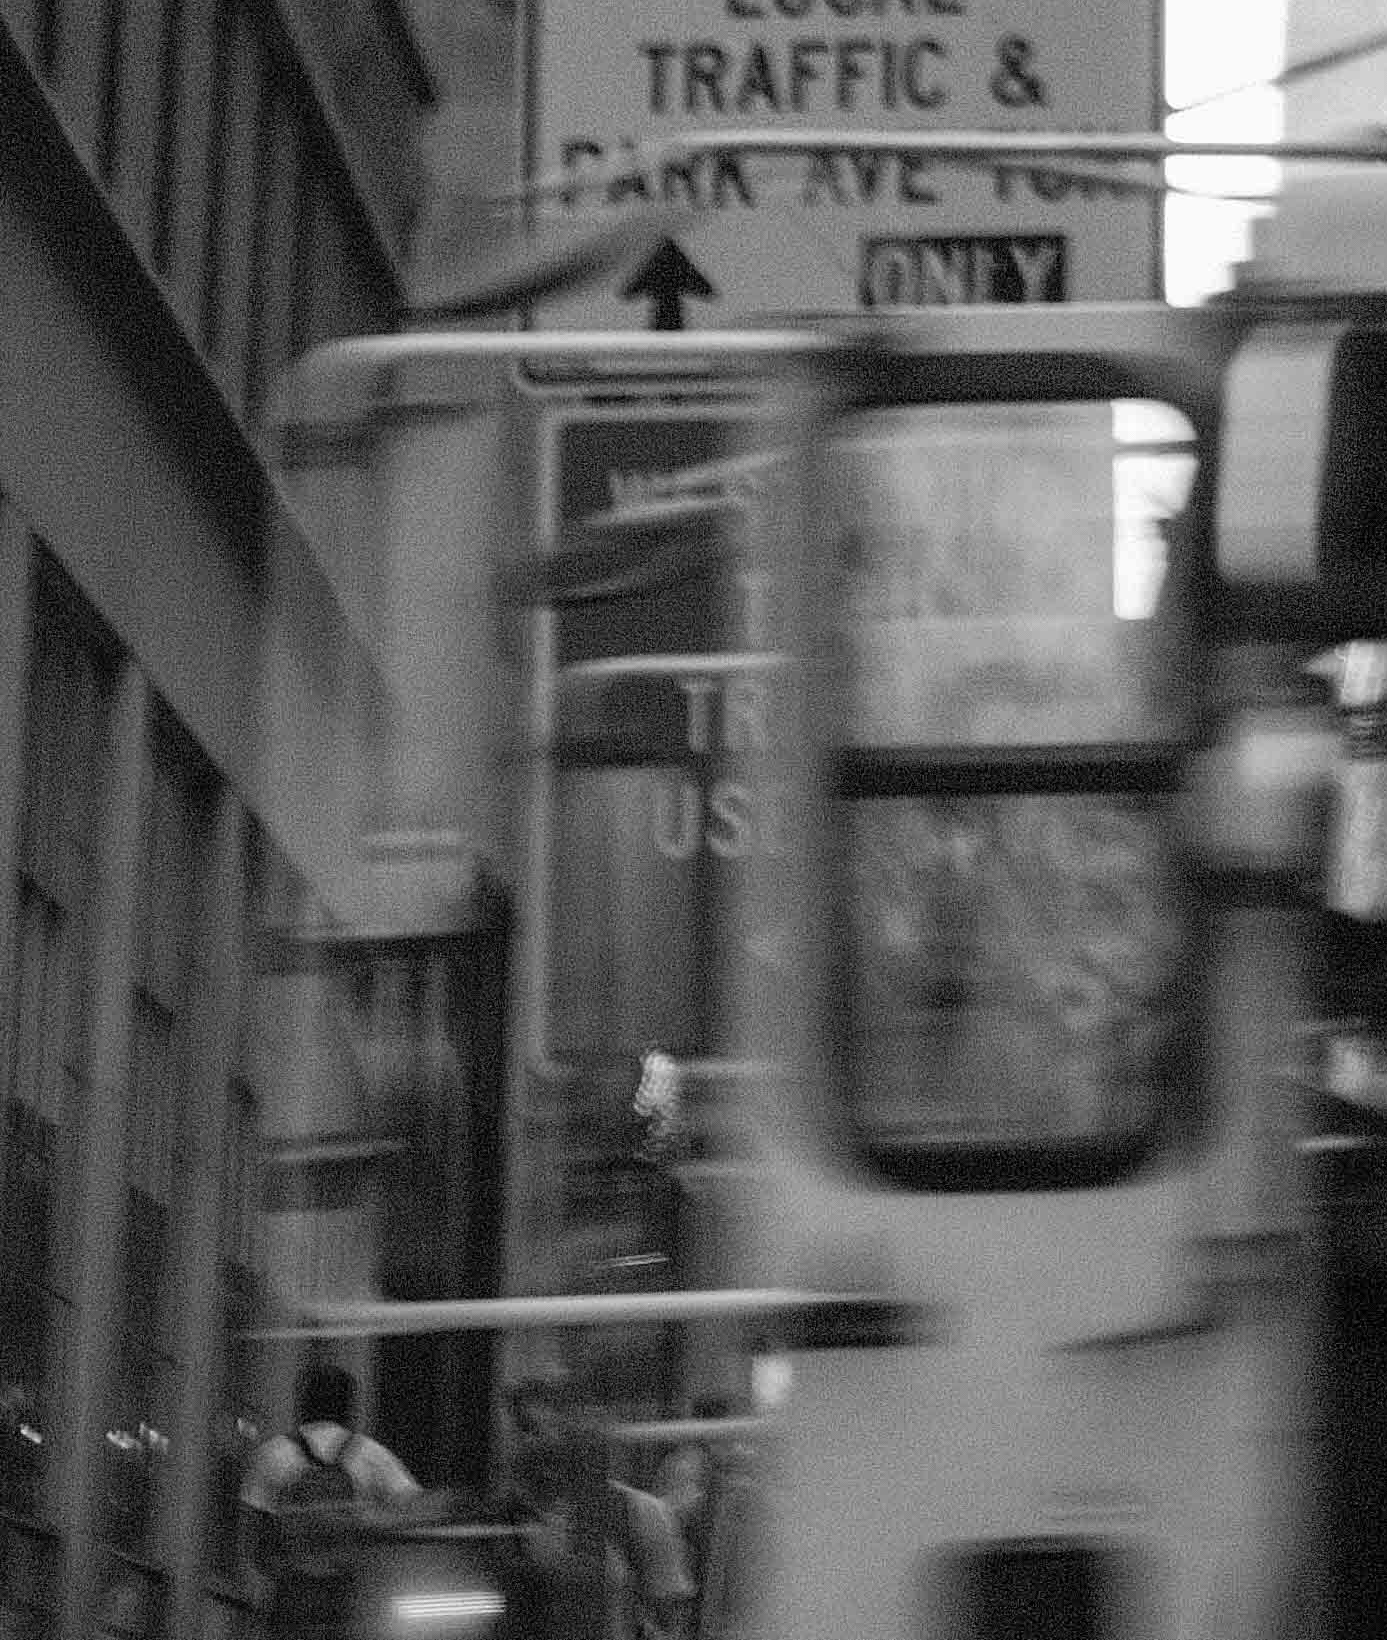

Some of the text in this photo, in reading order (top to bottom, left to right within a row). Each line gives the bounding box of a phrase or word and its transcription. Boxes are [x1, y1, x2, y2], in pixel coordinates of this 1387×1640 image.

[640, 37, 1048, 113] TRAFFIC &
[866, 241, 1058, 305] ONLY
